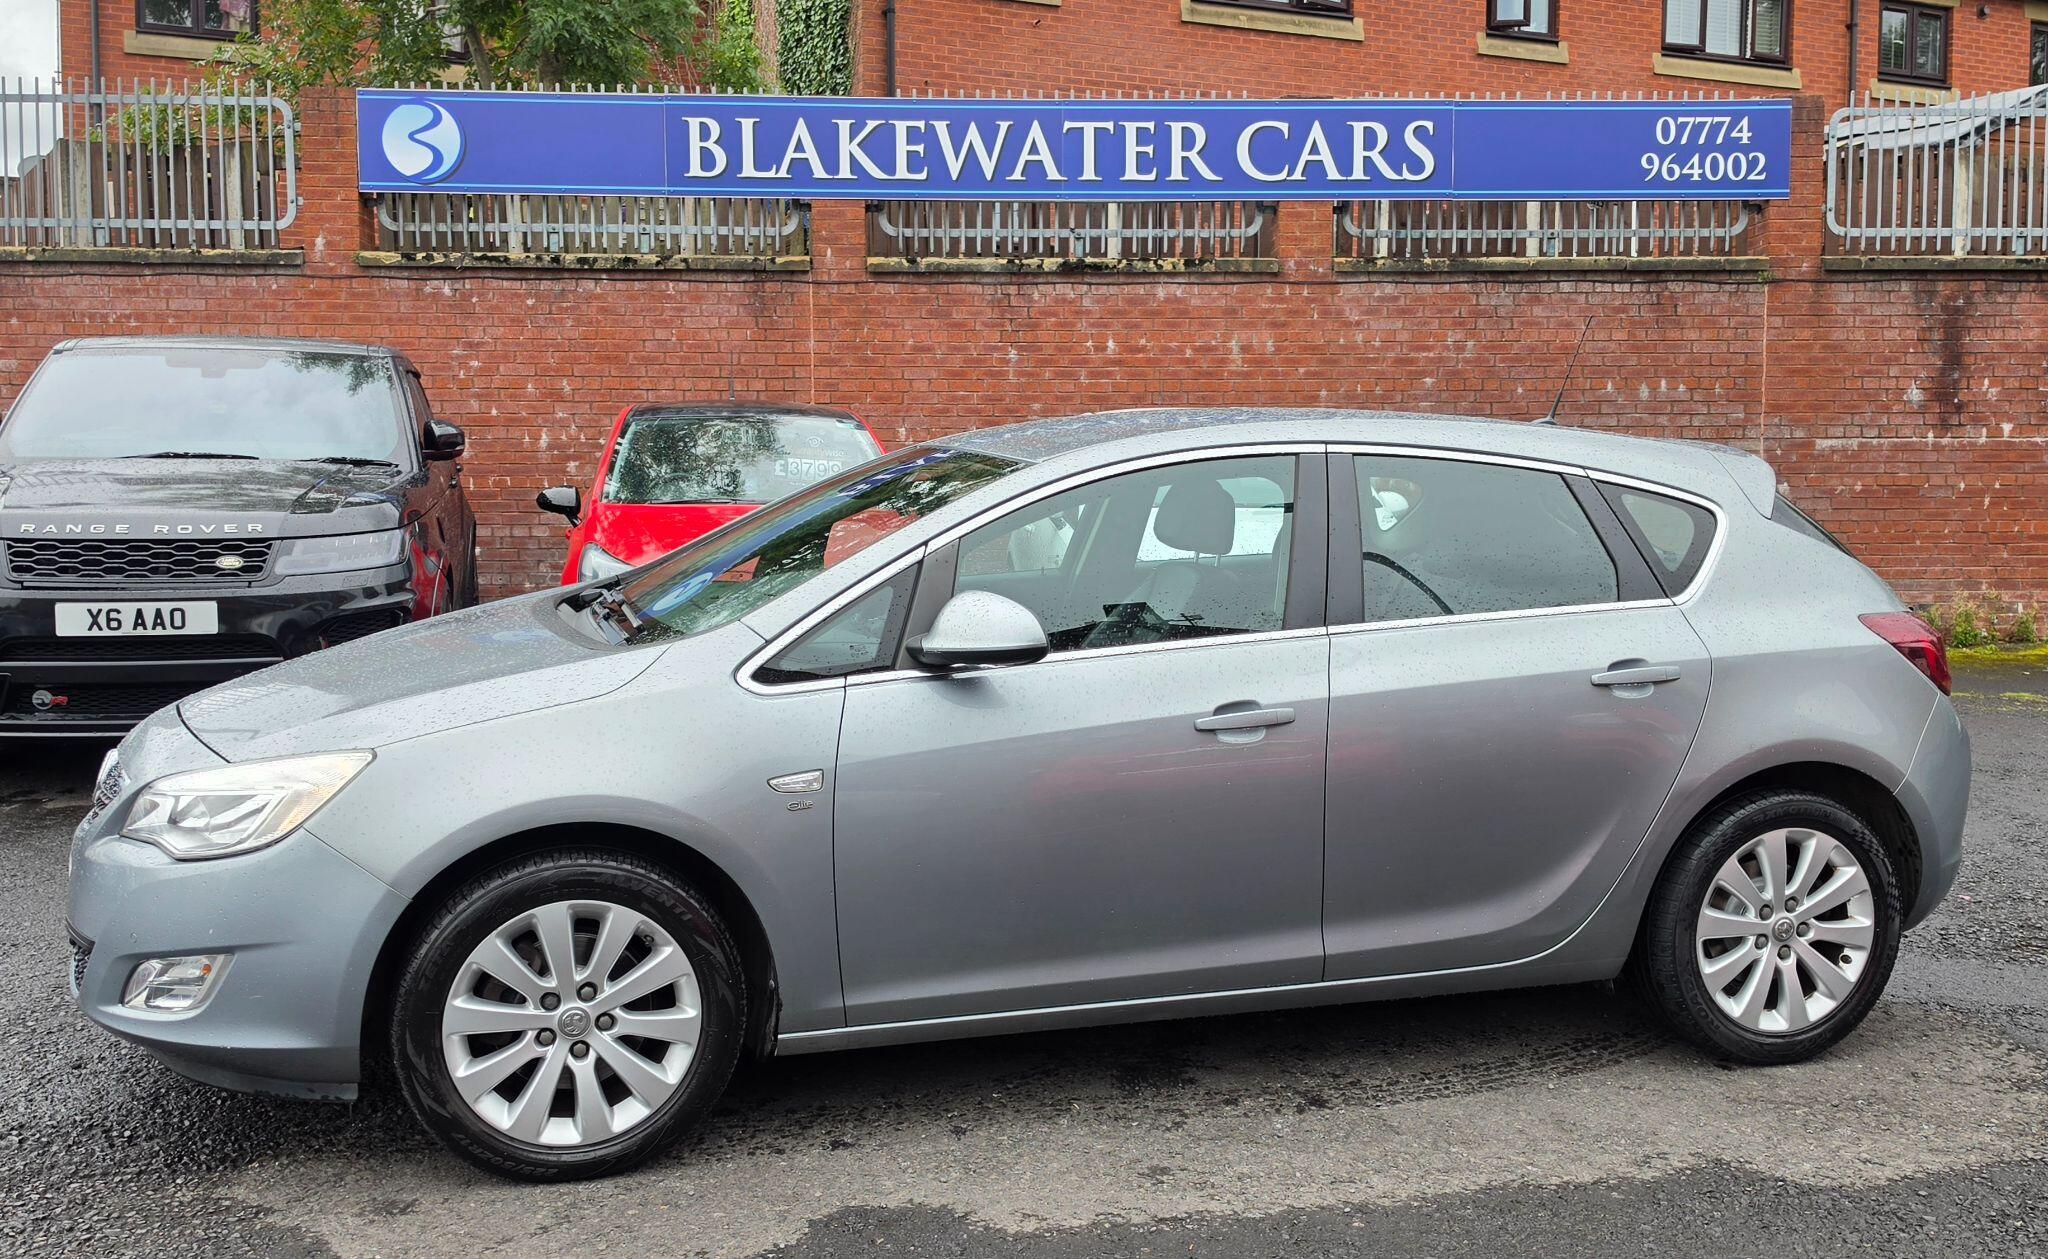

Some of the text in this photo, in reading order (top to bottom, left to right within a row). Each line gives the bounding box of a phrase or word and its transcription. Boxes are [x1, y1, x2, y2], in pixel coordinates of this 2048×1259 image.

[1655, 116, 1753, 145] 07774
[682, 116, 1436, 182] BLAKEWATER CARS
[1640, 152, 1767, 182] 964002
[20, 523, 263, 534] RANGE ROVER
[87, 607, 186, 632] X6 AAO
